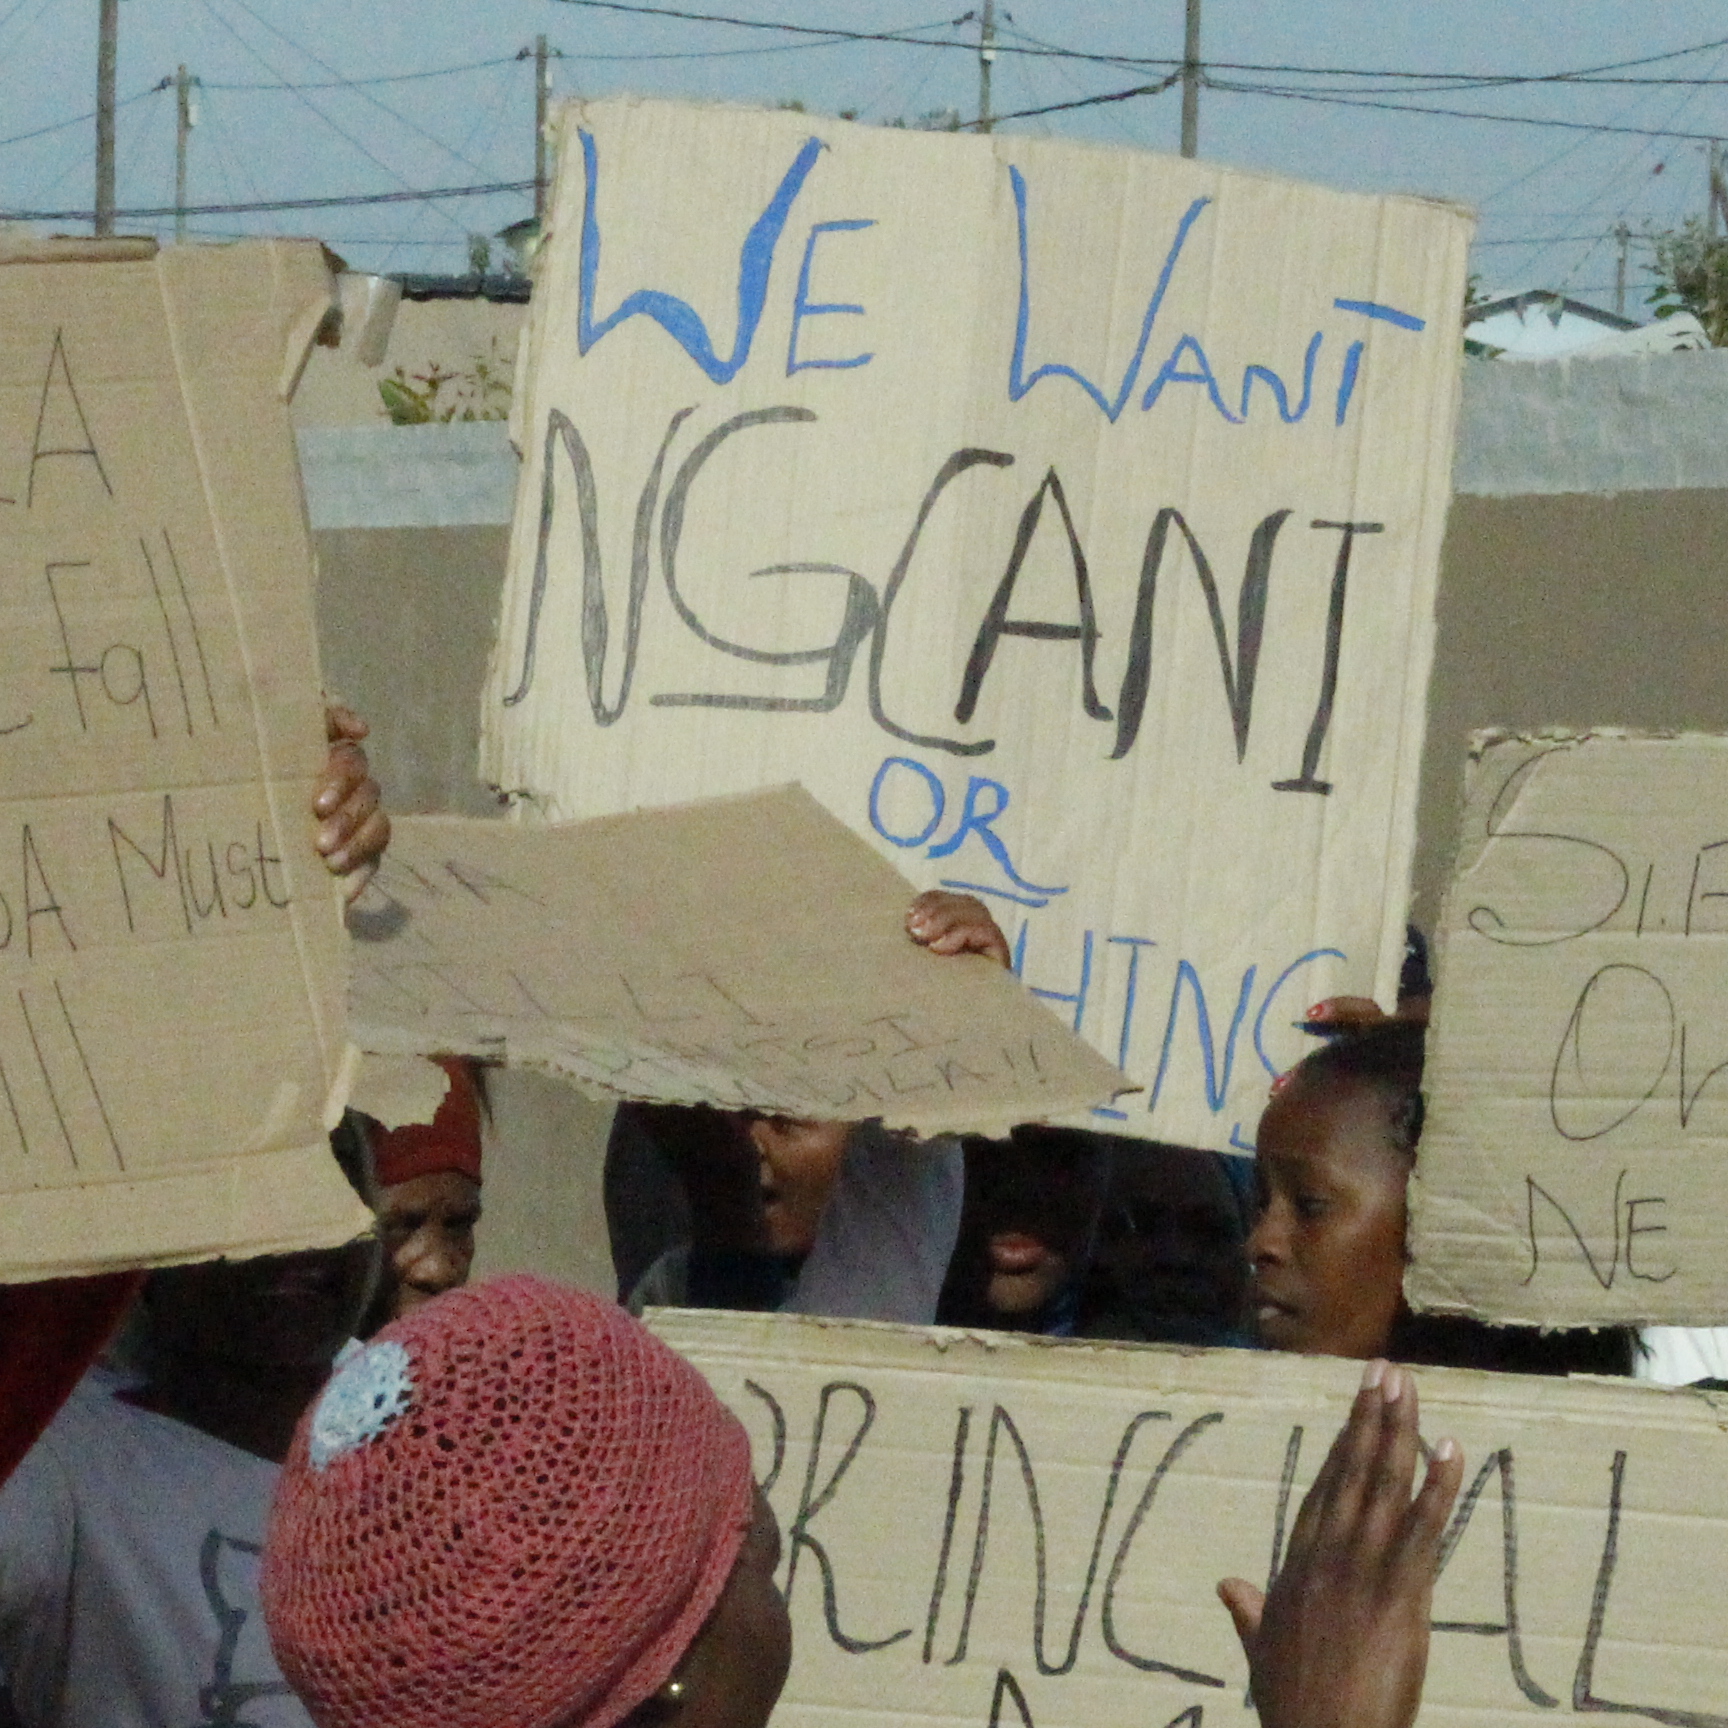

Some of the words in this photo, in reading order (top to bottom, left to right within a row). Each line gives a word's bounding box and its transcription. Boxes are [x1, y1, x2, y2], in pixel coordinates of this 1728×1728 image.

[576, 126, 880, 385] WE
[1008, 163, 1427, 424] WANT
[869, 755, 1068, 894] OR
[1520, 1169, 1676, 1290] NE
